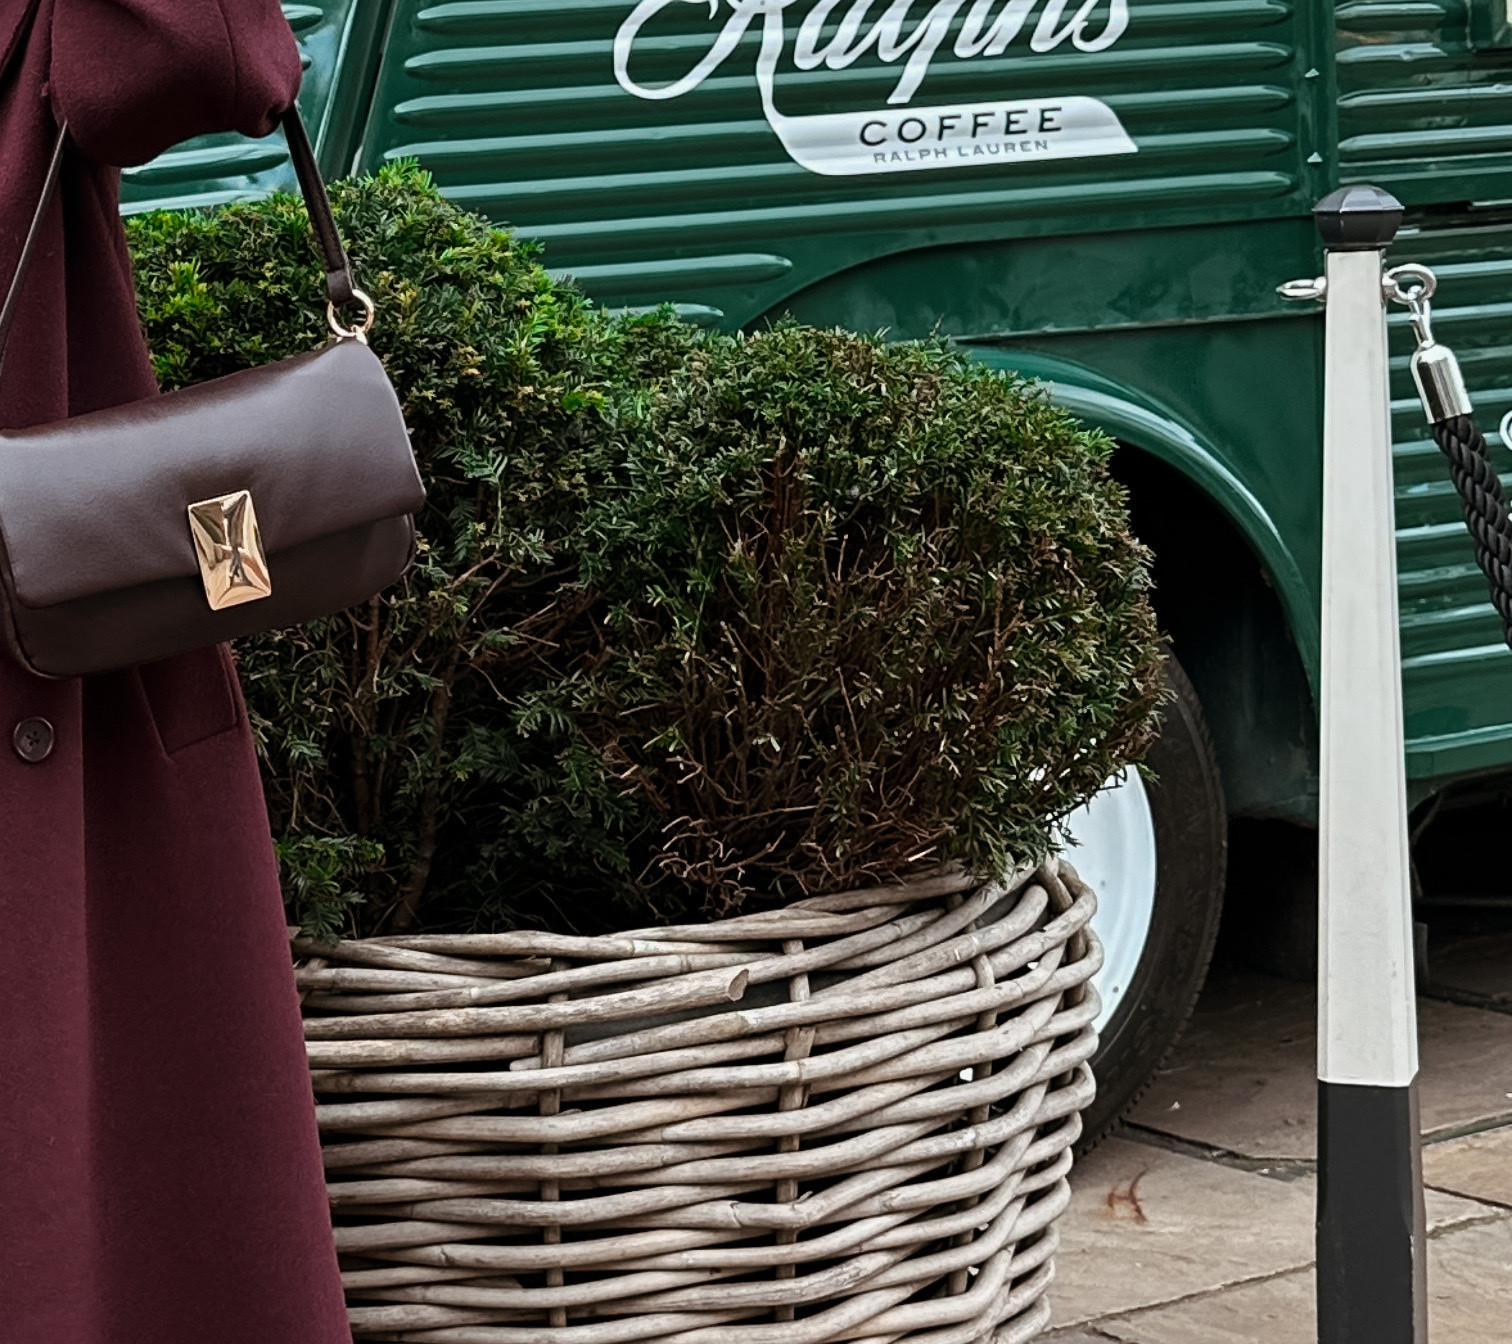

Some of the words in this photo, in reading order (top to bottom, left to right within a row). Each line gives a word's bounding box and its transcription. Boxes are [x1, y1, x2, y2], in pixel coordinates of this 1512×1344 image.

[859, 106, 1063, 147] COFFEE
[873, 146, 948, 164] RALPH
[957, 139, 1049, 157] LAUREN
